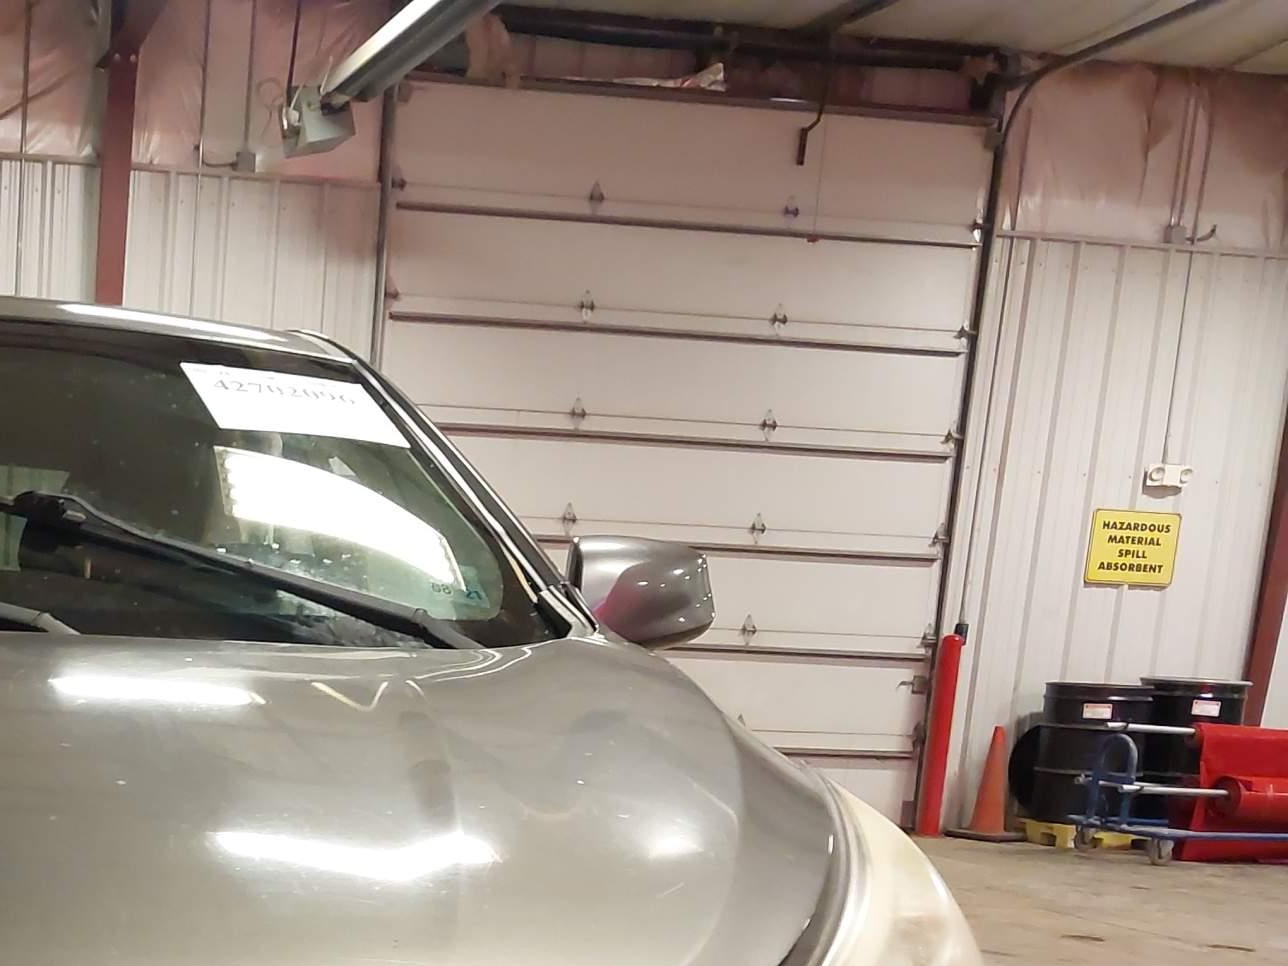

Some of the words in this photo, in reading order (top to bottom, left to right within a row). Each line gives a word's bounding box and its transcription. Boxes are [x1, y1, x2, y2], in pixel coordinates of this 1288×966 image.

[1102, 520, 1171, 533] HAZARDOUS
[1107, 535, 1162, 547] MATERIAL
[1117, 549, 1148, 559] SPILL
[1097, 562, 1164, 574] ABSORBENT
